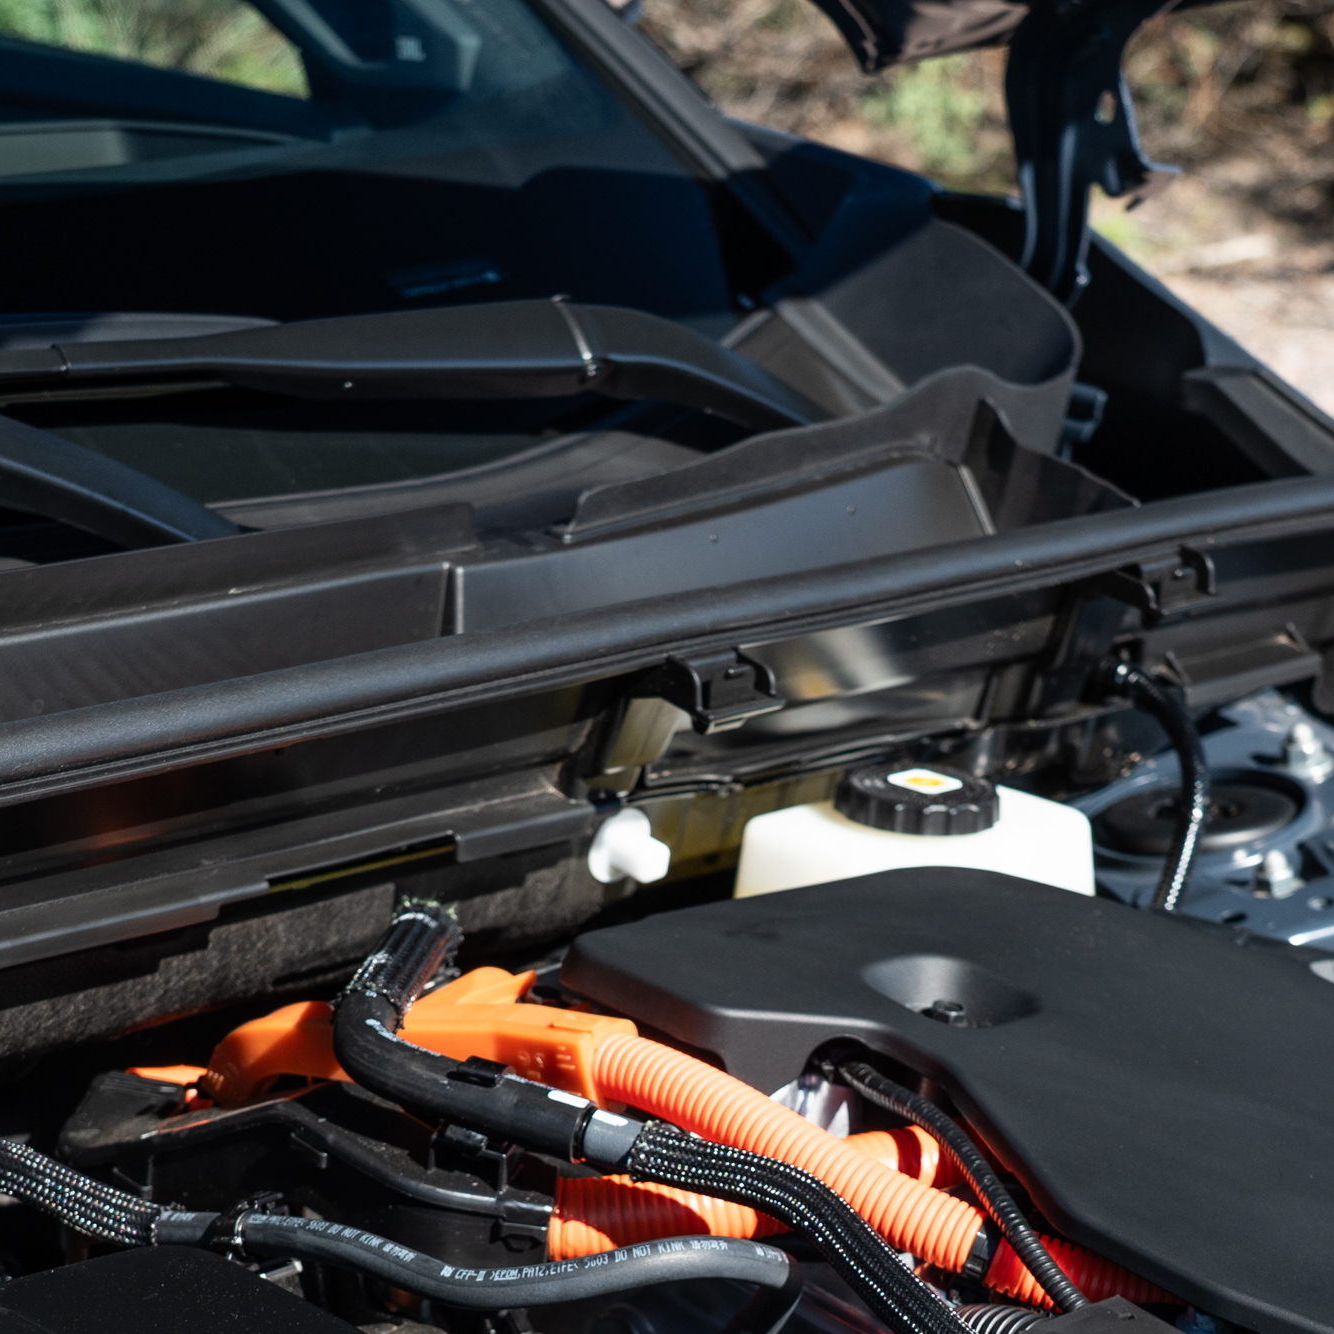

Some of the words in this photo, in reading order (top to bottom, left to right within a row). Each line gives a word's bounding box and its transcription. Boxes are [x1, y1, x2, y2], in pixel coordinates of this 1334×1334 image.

[614, 1249, 629, 1263] DO
[632, 1244, 652, 1258] NOT
[658, 1240, 685, 1254] KINK
